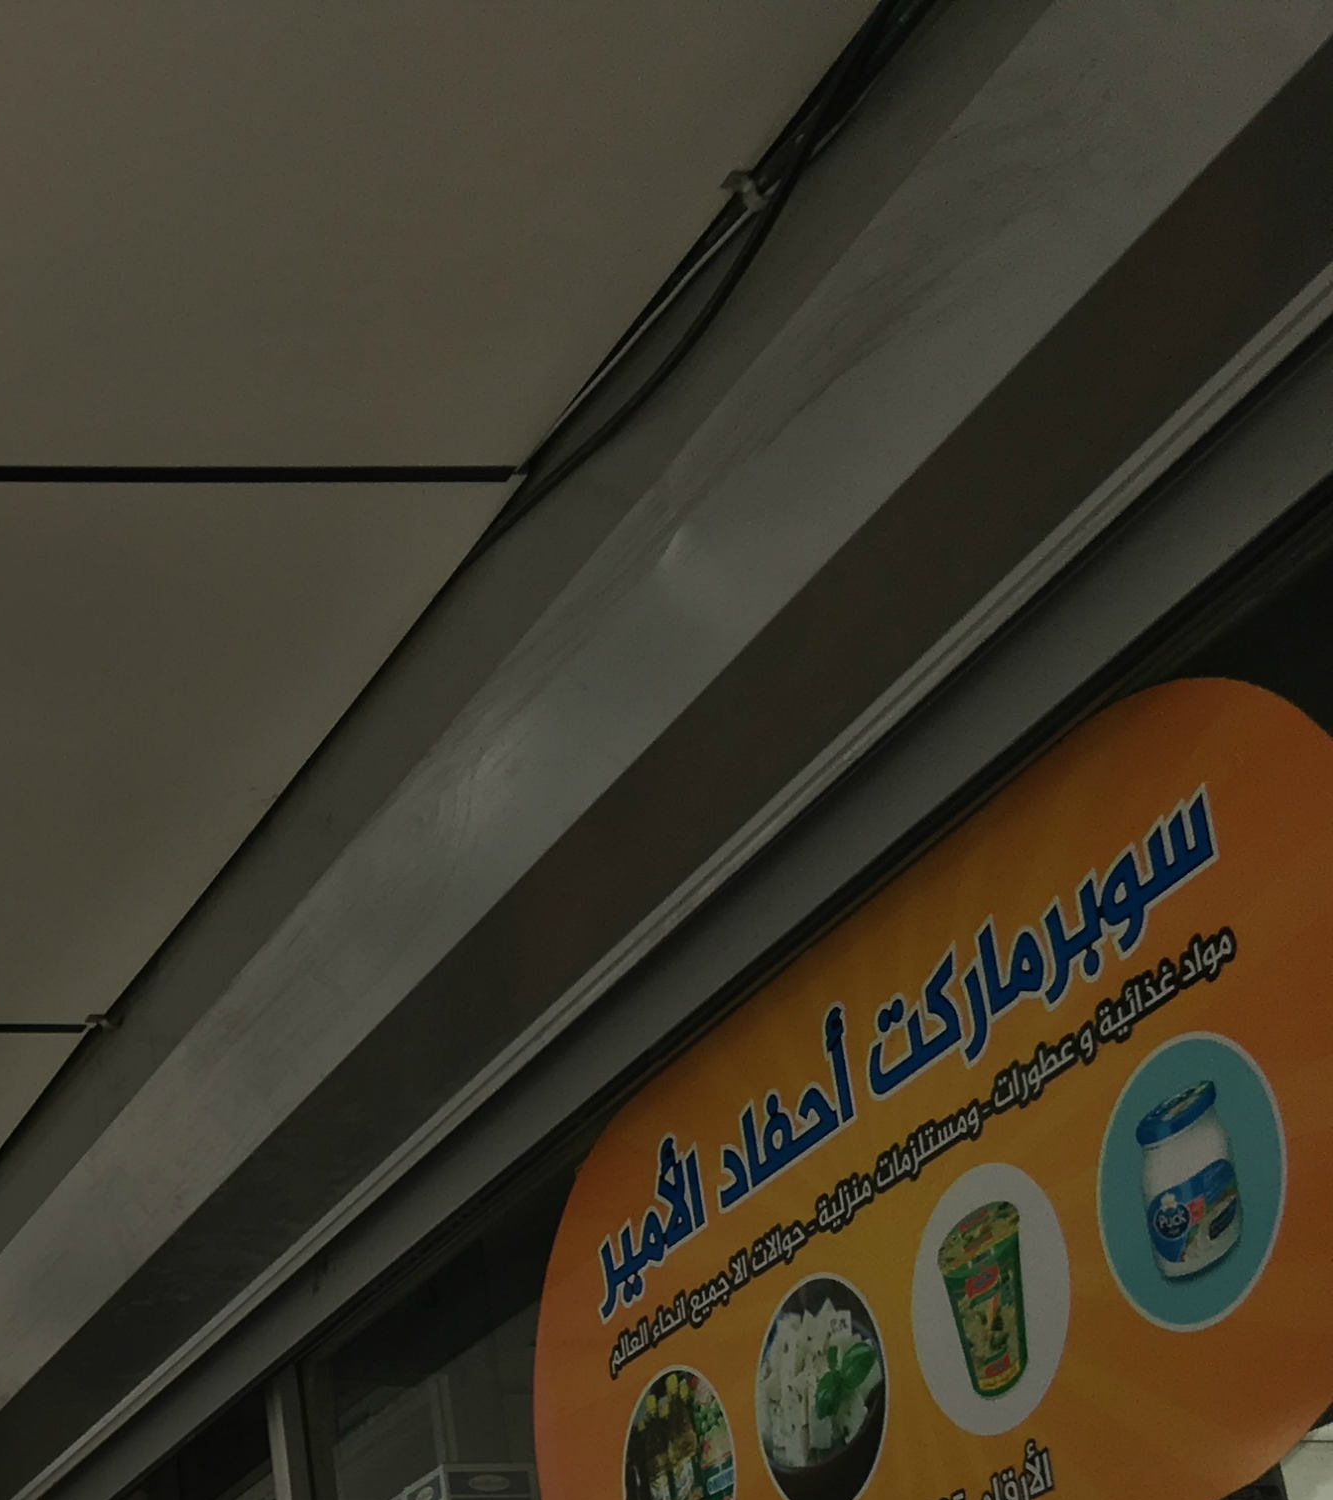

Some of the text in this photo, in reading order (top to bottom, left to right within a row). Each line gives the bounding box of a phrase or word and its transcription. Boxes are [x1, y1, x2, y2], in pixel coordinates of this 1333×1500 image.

[1181, 930, 1234, 981] مواد
[599, 784, 1218, 1321] سوبرماركت أحفاد الأمير
[609, 1319, 650, 1377] العالم
